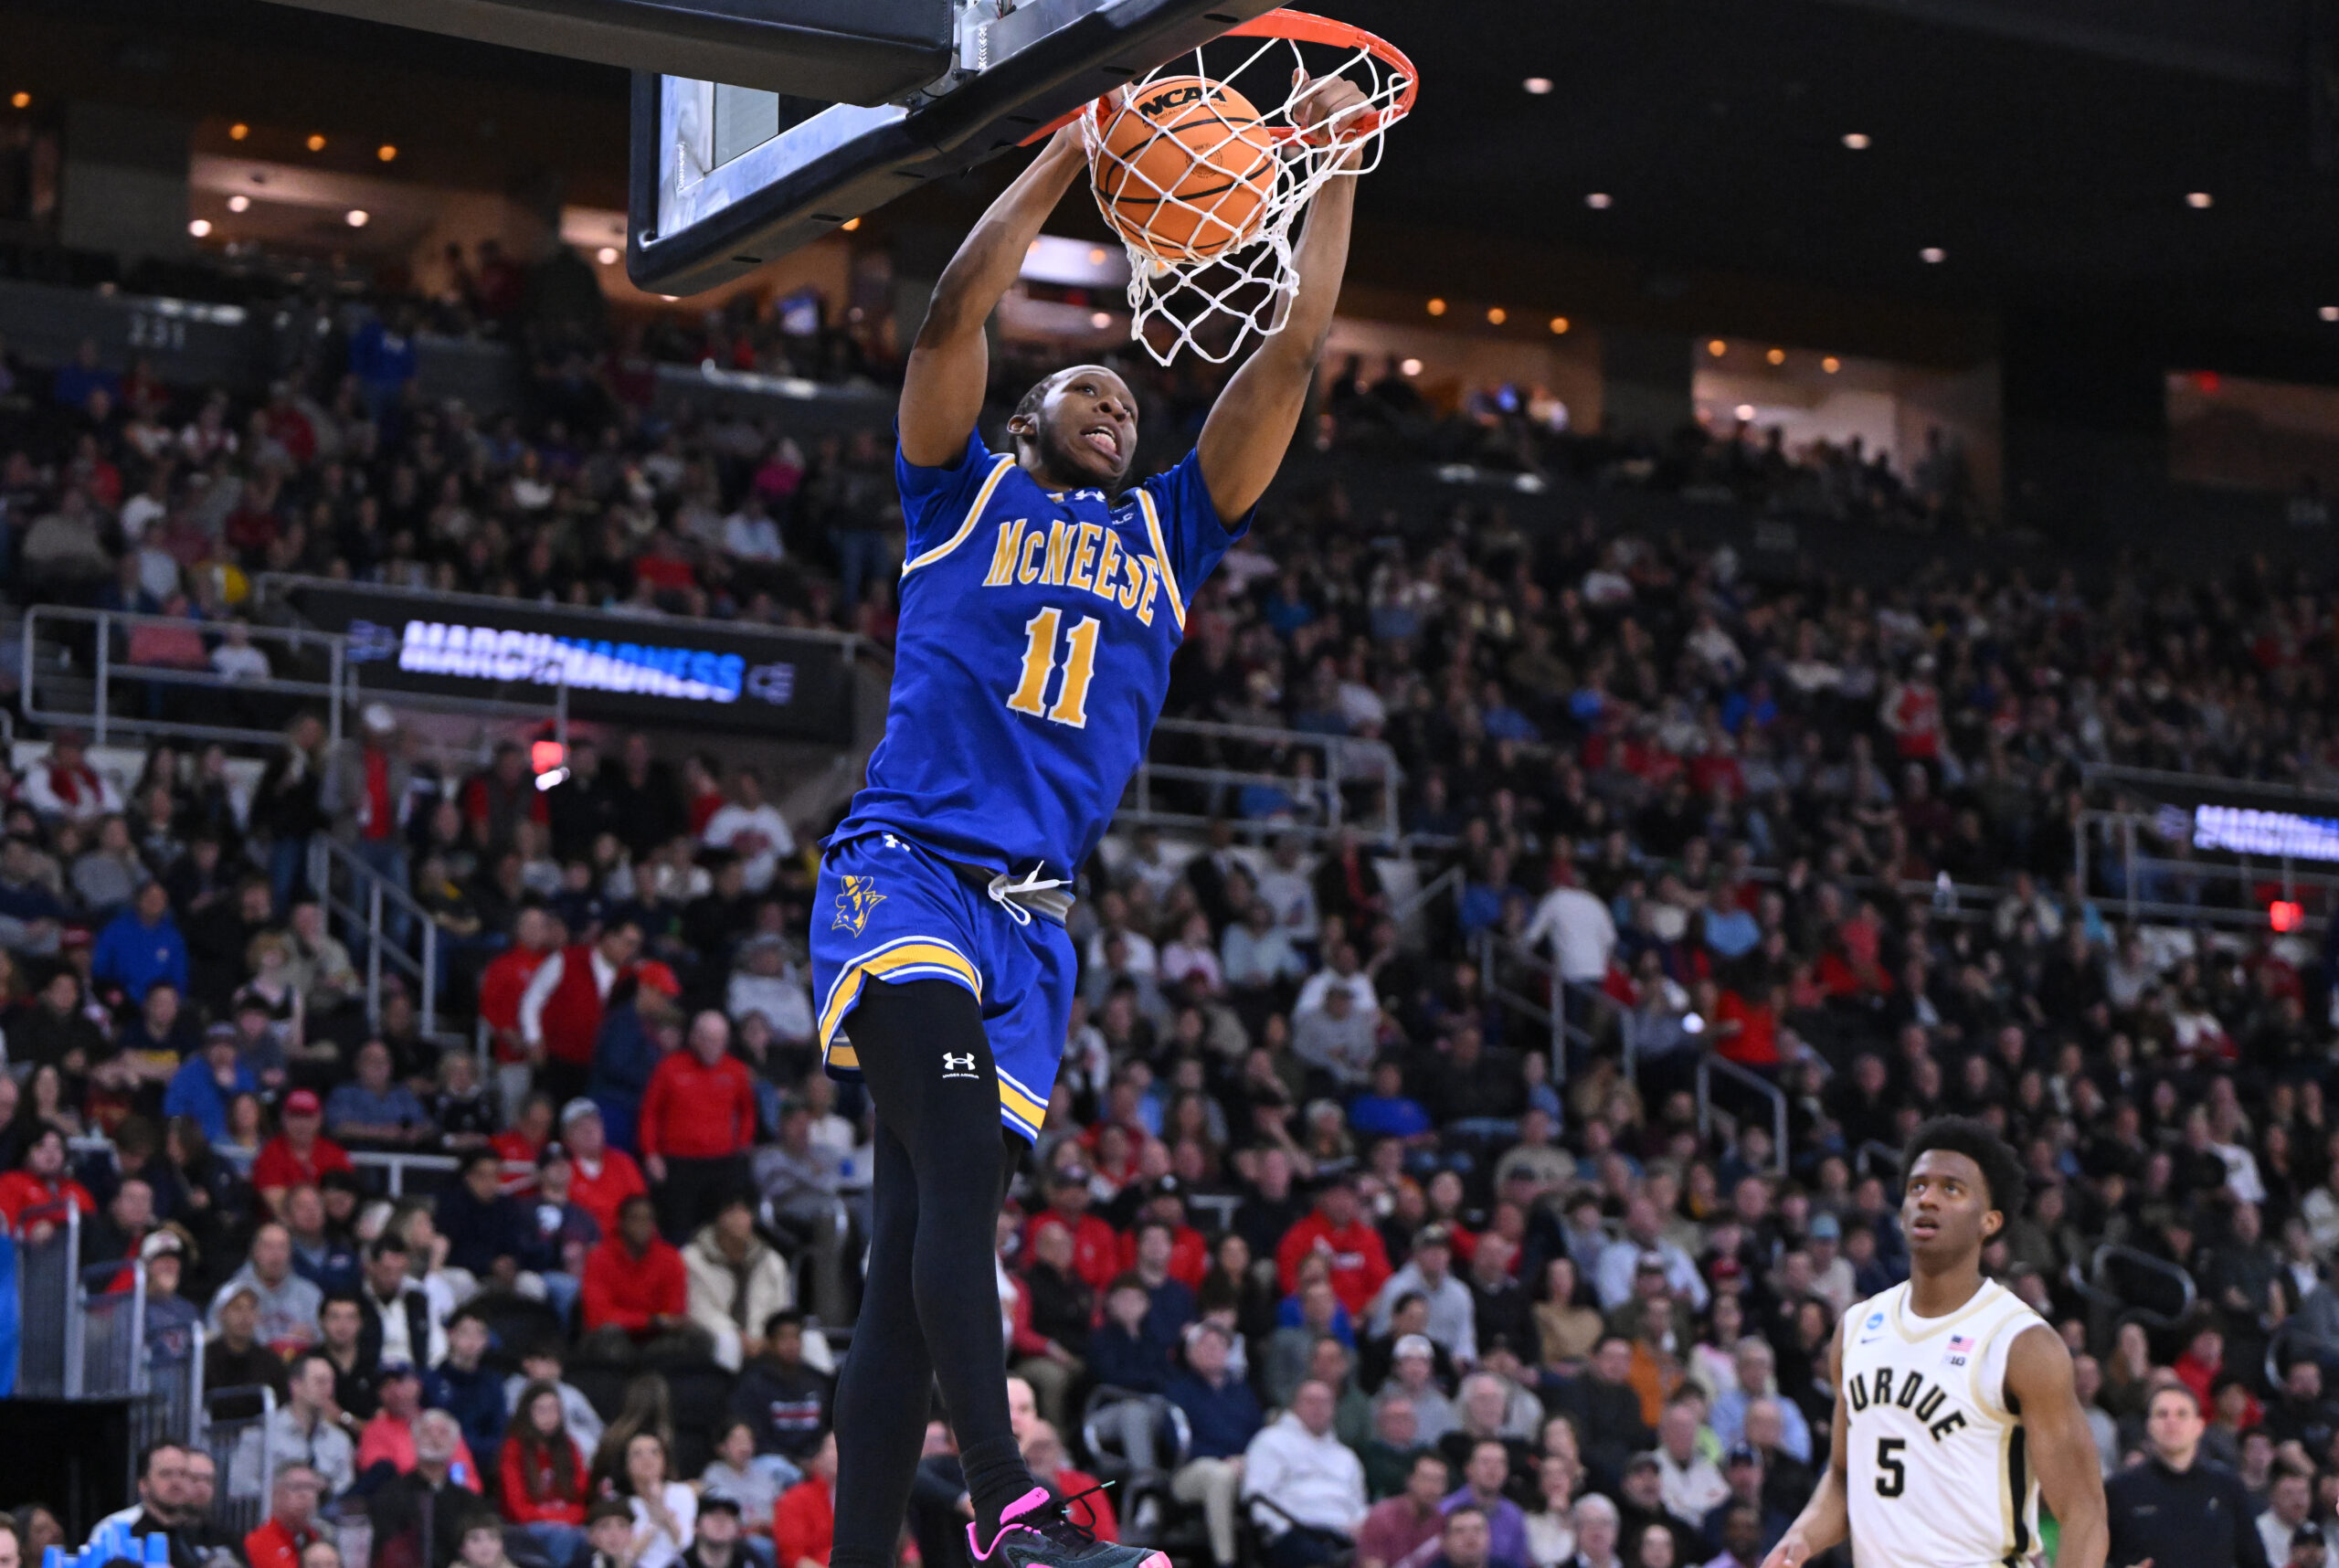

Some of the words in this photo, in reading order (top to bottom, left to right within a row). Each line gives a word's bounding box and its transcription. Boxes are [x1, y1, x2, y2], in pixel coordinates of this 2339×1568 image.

[1138, 87, 1226, 125] NCAA
[1006, 606, 1101, 730] 11
[1846, 1366, 1967, 1443] URDUE
[1875, 1436, 1906, 1499] 5
